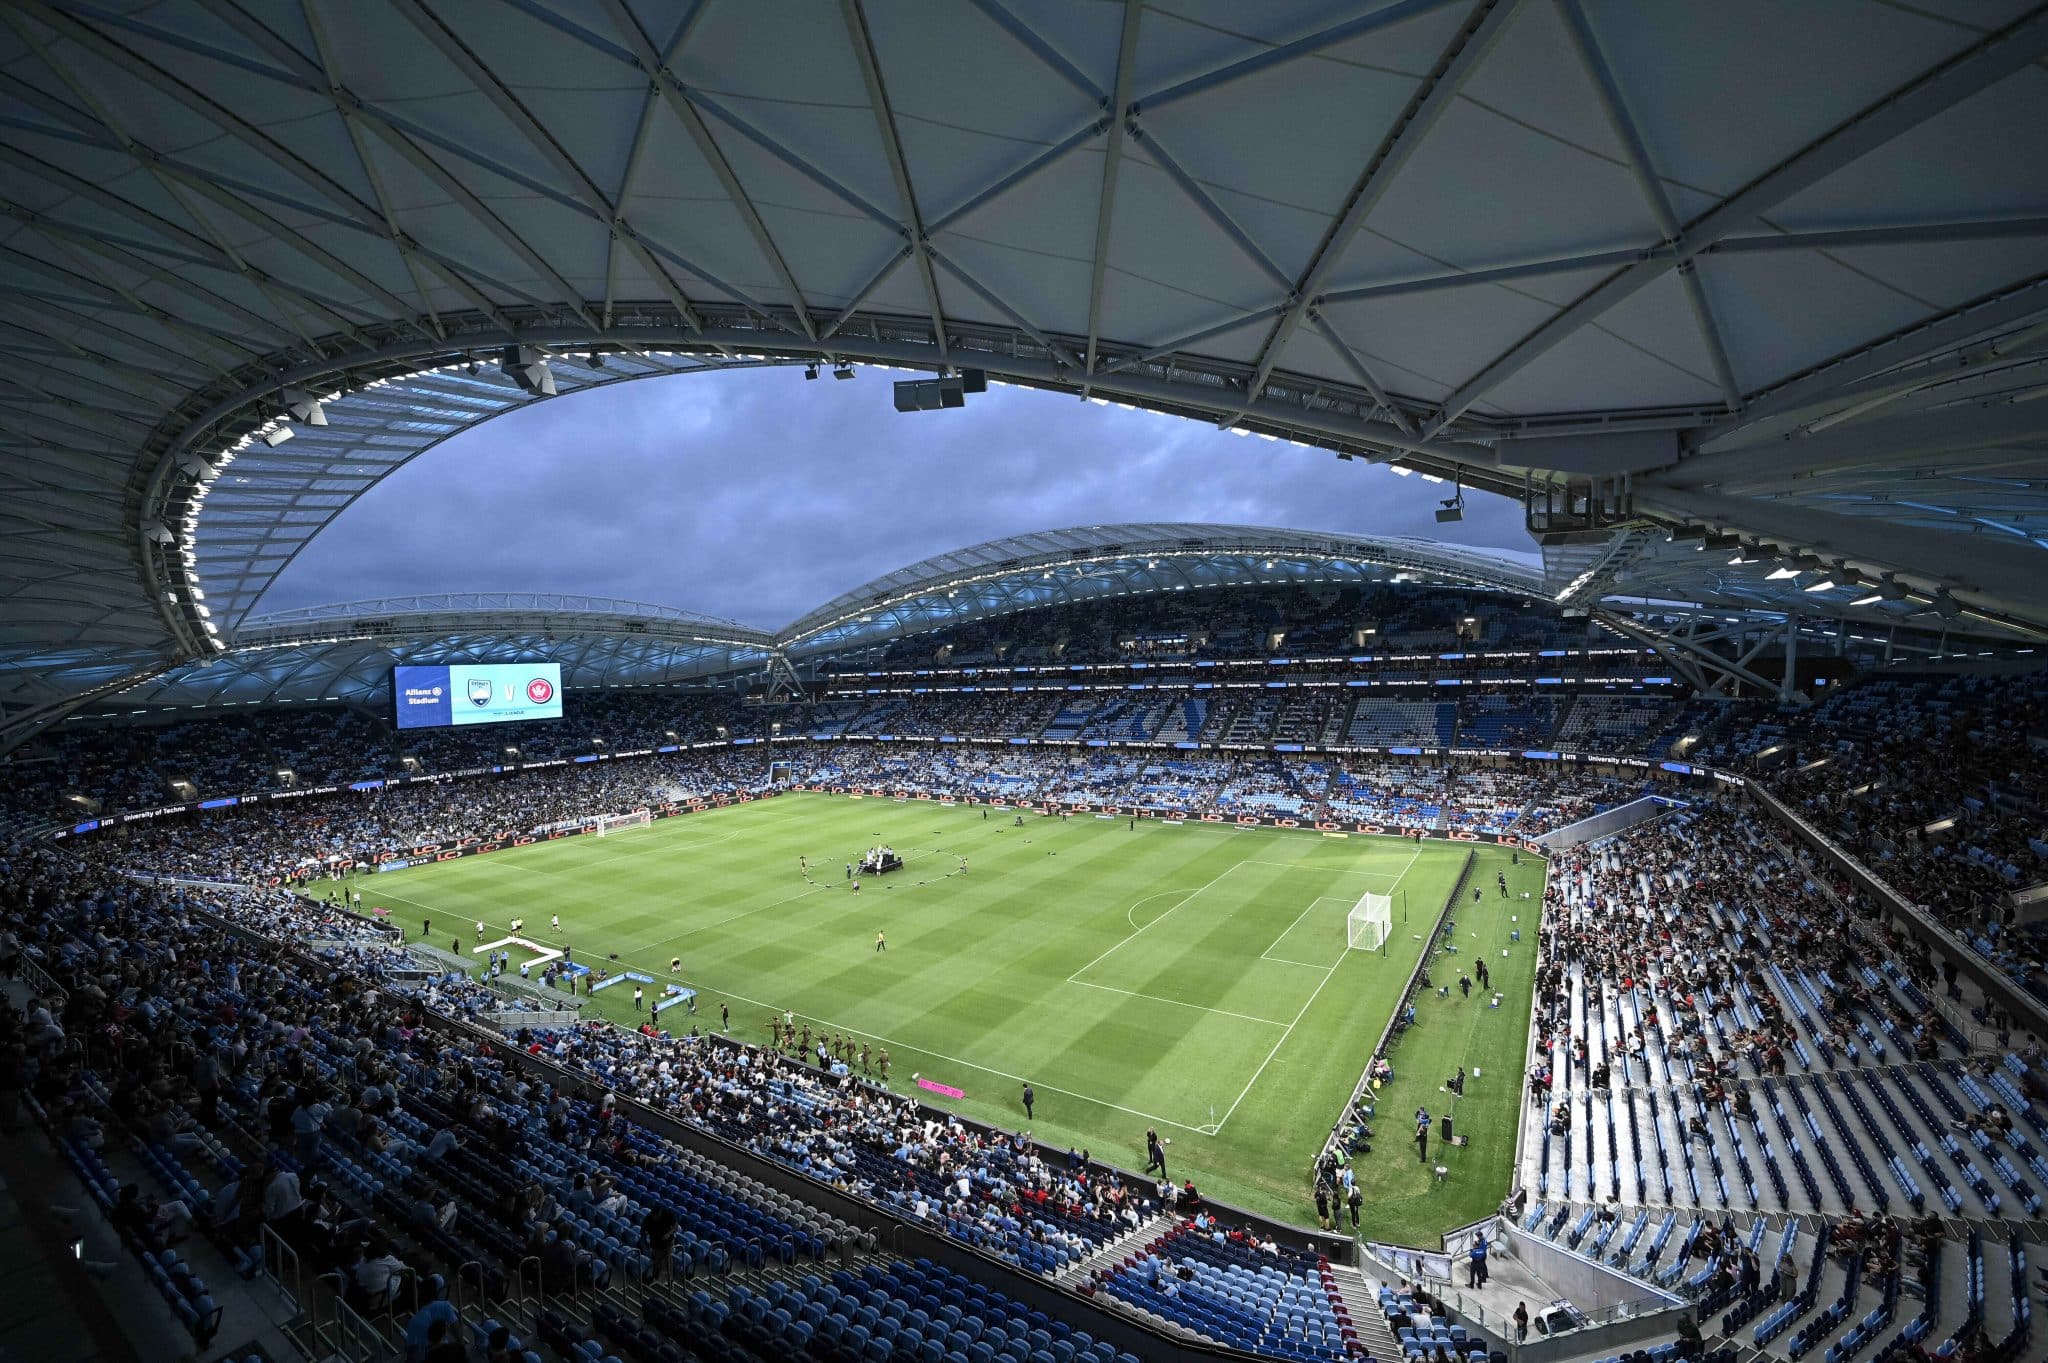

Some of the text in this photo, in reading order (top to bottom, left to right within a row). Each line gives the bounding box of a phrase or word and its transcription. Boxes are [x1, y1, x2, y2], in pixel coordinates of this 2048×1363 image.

[405, 688, 432, 697] Allianz
[408, 697, 439, 705] Stadium
[1588, 755, 1620, 765] University
[271, 790, 305, 799] University
[123, 811, 153, 822] University
